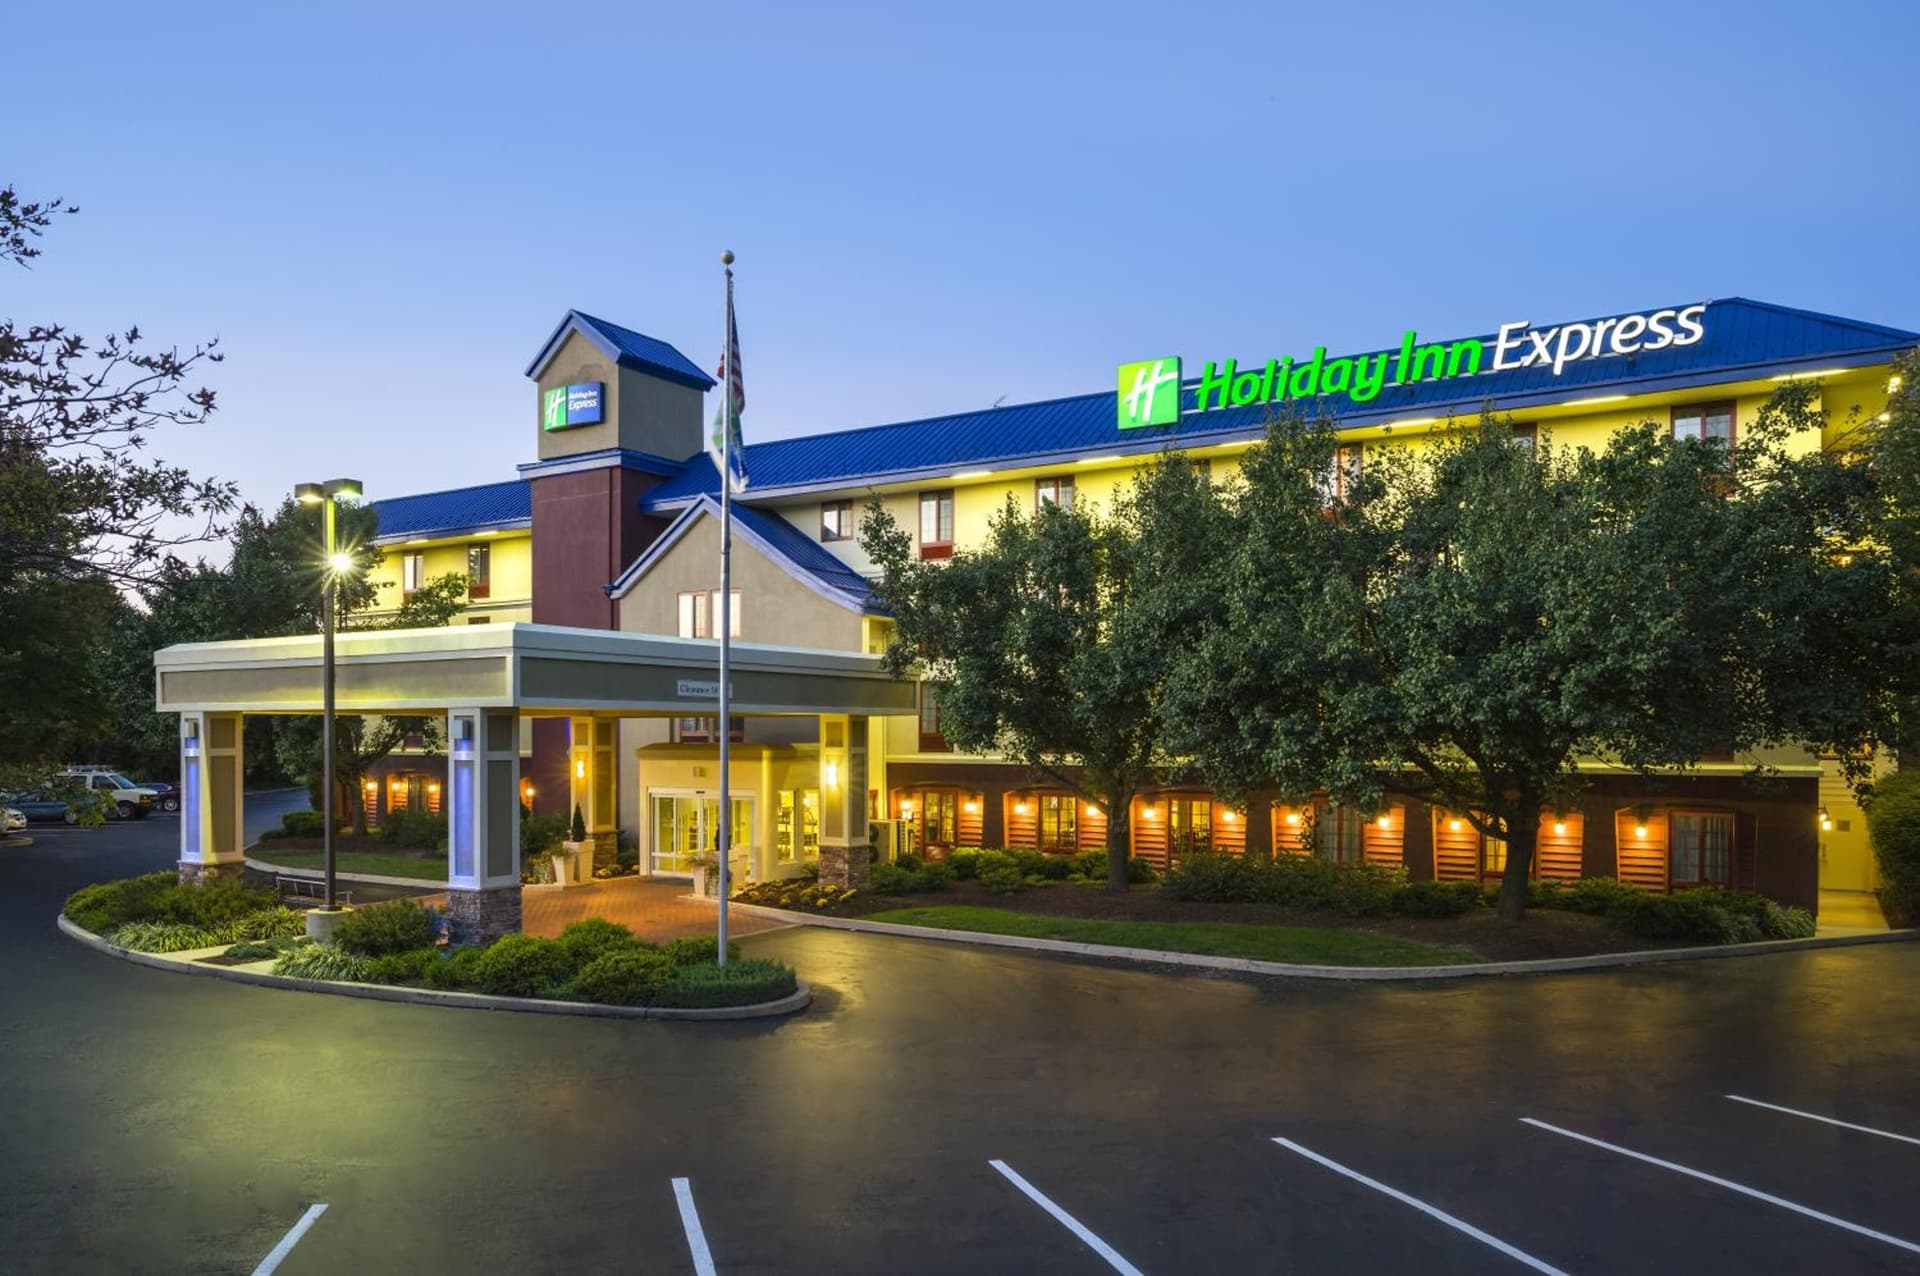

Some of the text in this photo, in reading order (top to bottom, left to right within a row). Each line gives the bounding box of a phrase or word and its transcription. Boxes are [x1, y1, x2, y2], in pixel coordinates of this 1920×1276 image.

[1196, 304, 1707, 411] Holiday Inn Express
[568, 399, 598, 411] Express
